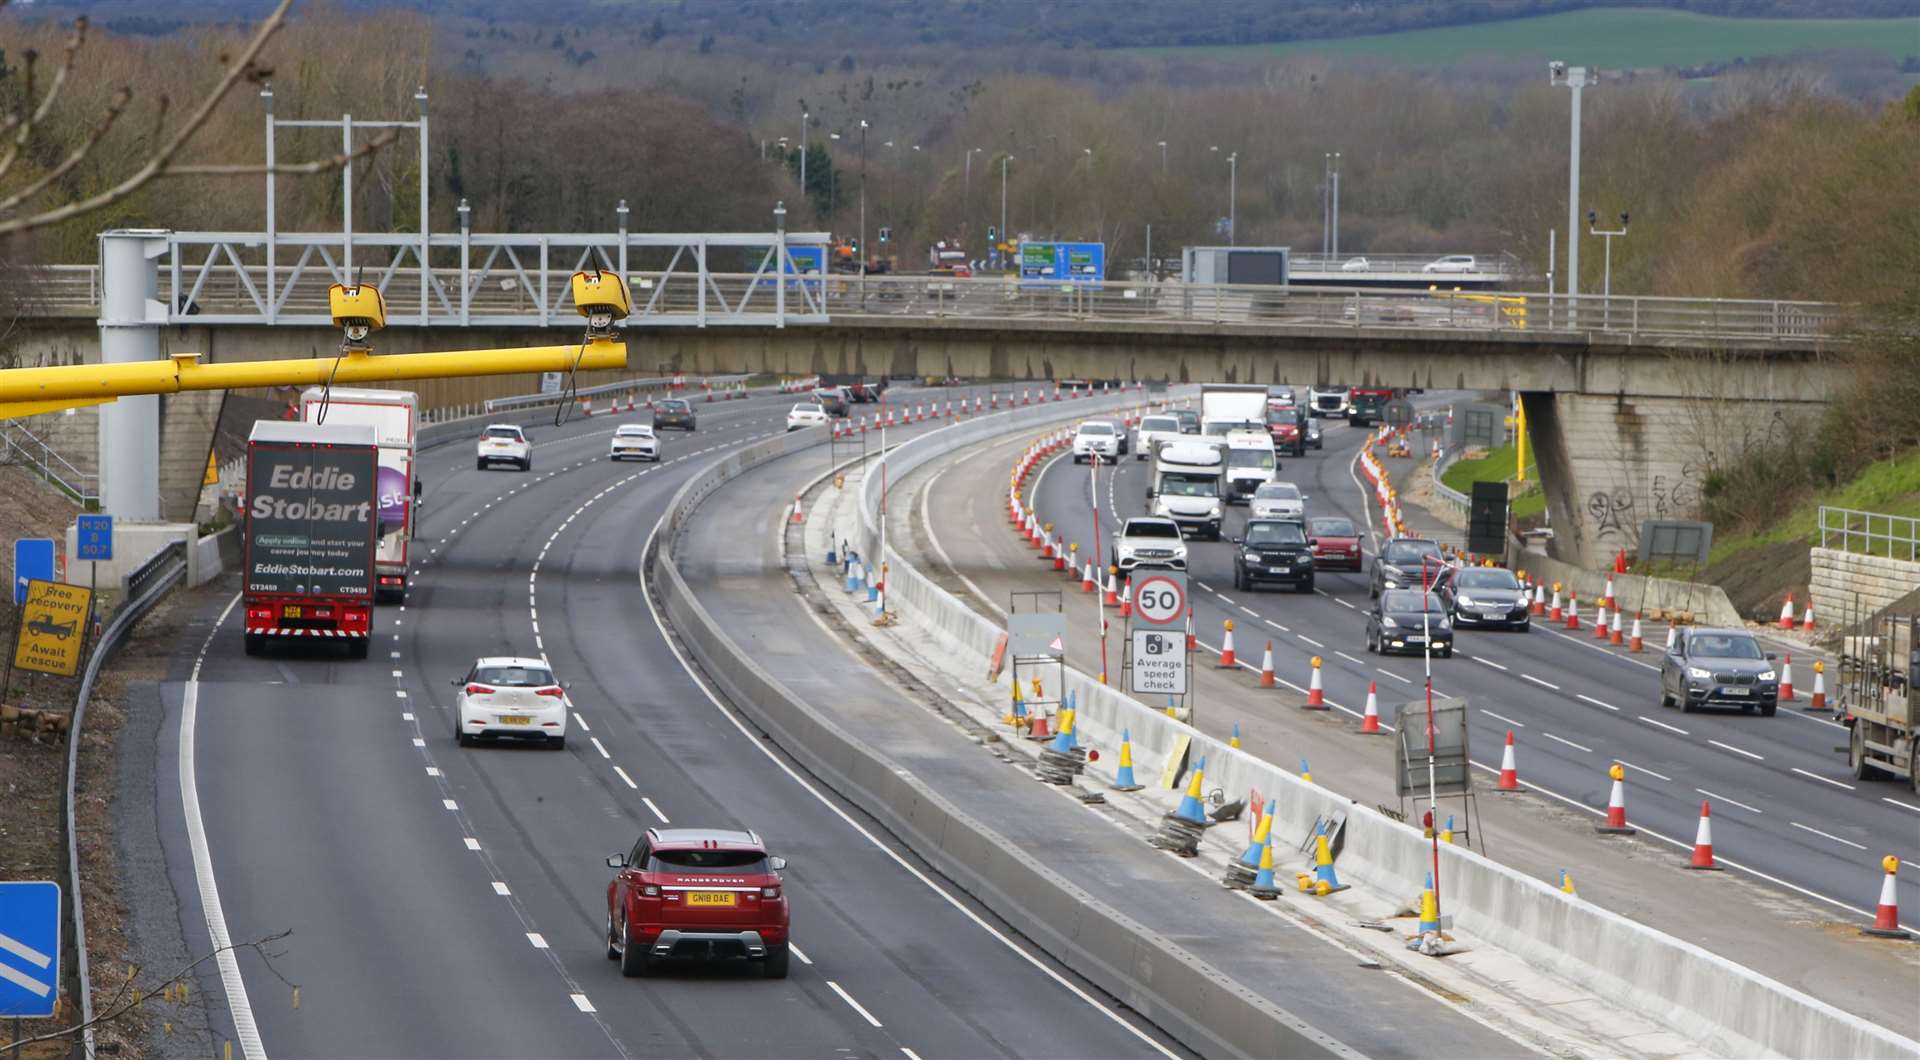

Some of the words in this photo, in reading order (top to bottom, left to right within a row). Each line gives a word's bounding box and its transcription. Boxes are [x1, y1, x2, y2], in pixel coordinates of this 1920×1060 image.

[270, 465, 355, 490] Eddie
[251, 495, 371, 522] Stobart
[258, 536, 281, 546] Apply
[283, 536, 307, 545] online
[347, 540, 365, 548] your
[328, 550, 350, 558] today
[255, 563, 365, 577] EddieStobart.com
[47, 586, 73, 599] Free
[31, 598, 84, 615] recovery
[1142, 590, 1176, 610] 50
[31, 642, 67, 658] Await
[25, 656, 66, 669] rescue
[1137, 659, 1182, 669] Average
[1144, 671, 1175, 679] speed
[1144, 680, 1175, 689] check
